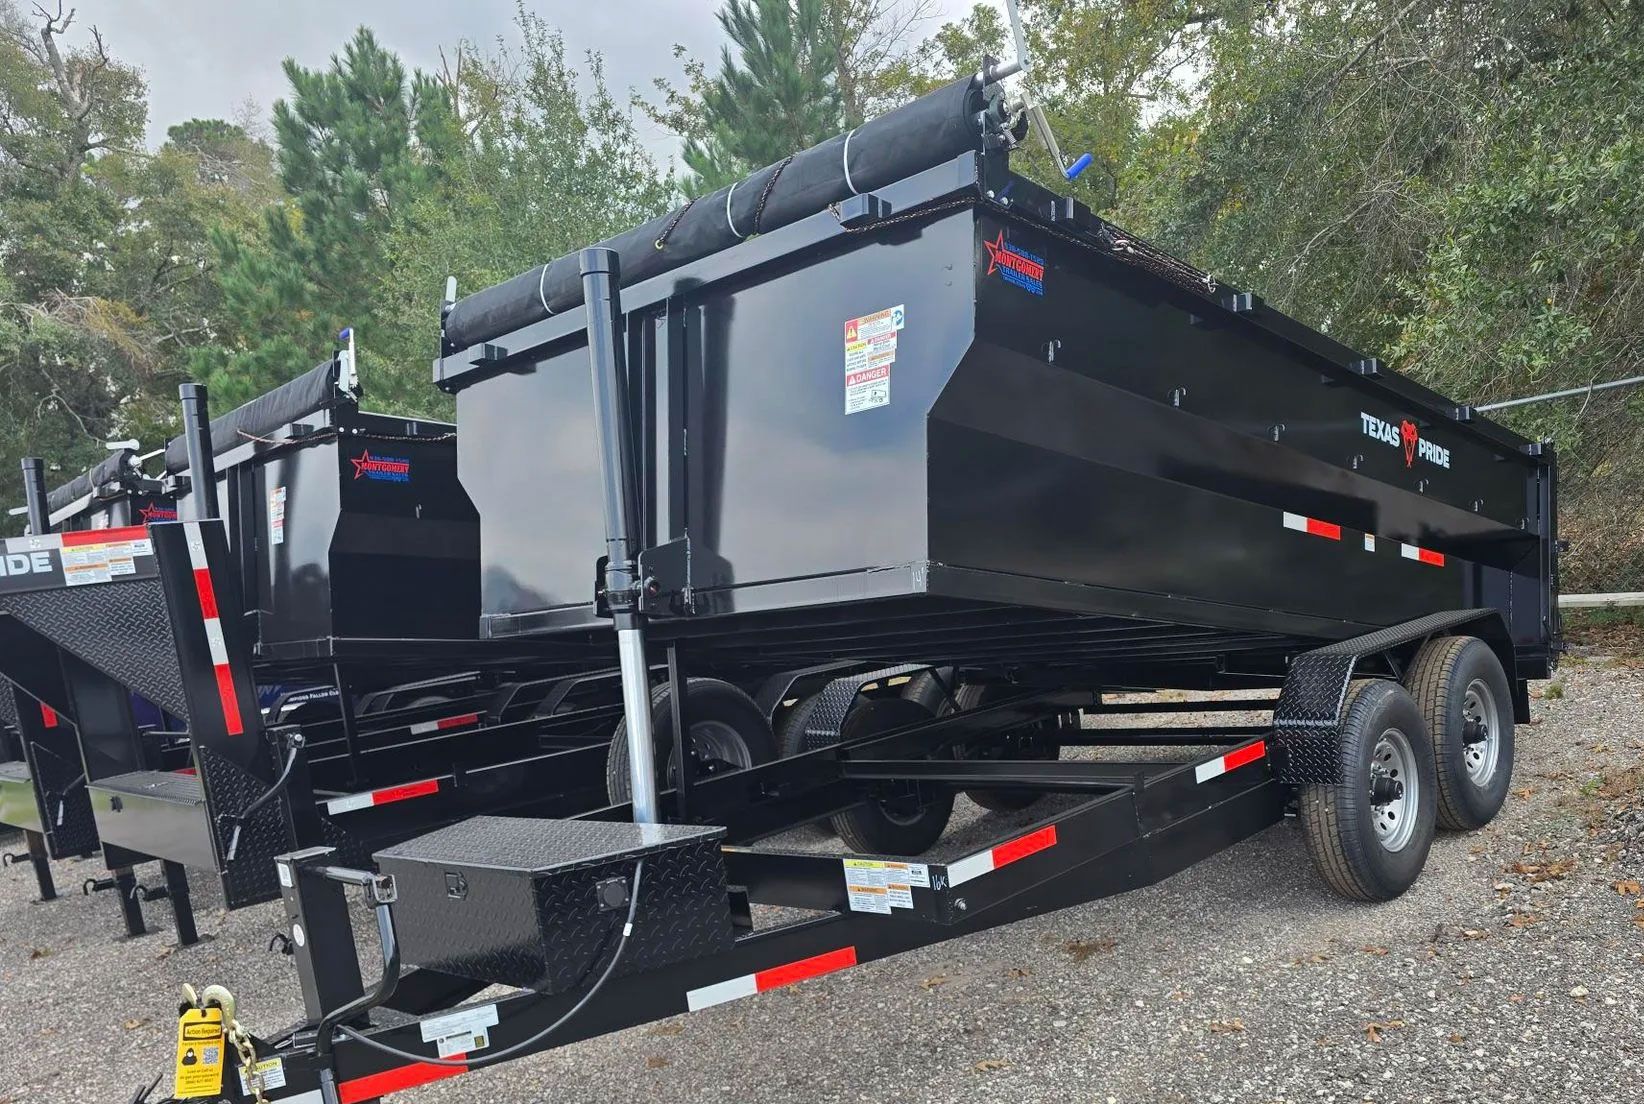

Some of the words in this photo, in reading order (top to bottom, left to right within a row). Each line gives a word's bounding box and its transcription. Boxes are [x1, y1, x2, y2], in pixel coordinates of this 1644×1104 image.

[995, 249, 1044, 280] MONTGOMERY
[856, 367, 887, 383] DANGER
[1360, 411, 1400, 448] TEXAS
[1418, 437, 1450, 469] PRIDE
[361, 462, 409, 473] MONTGOMERY
